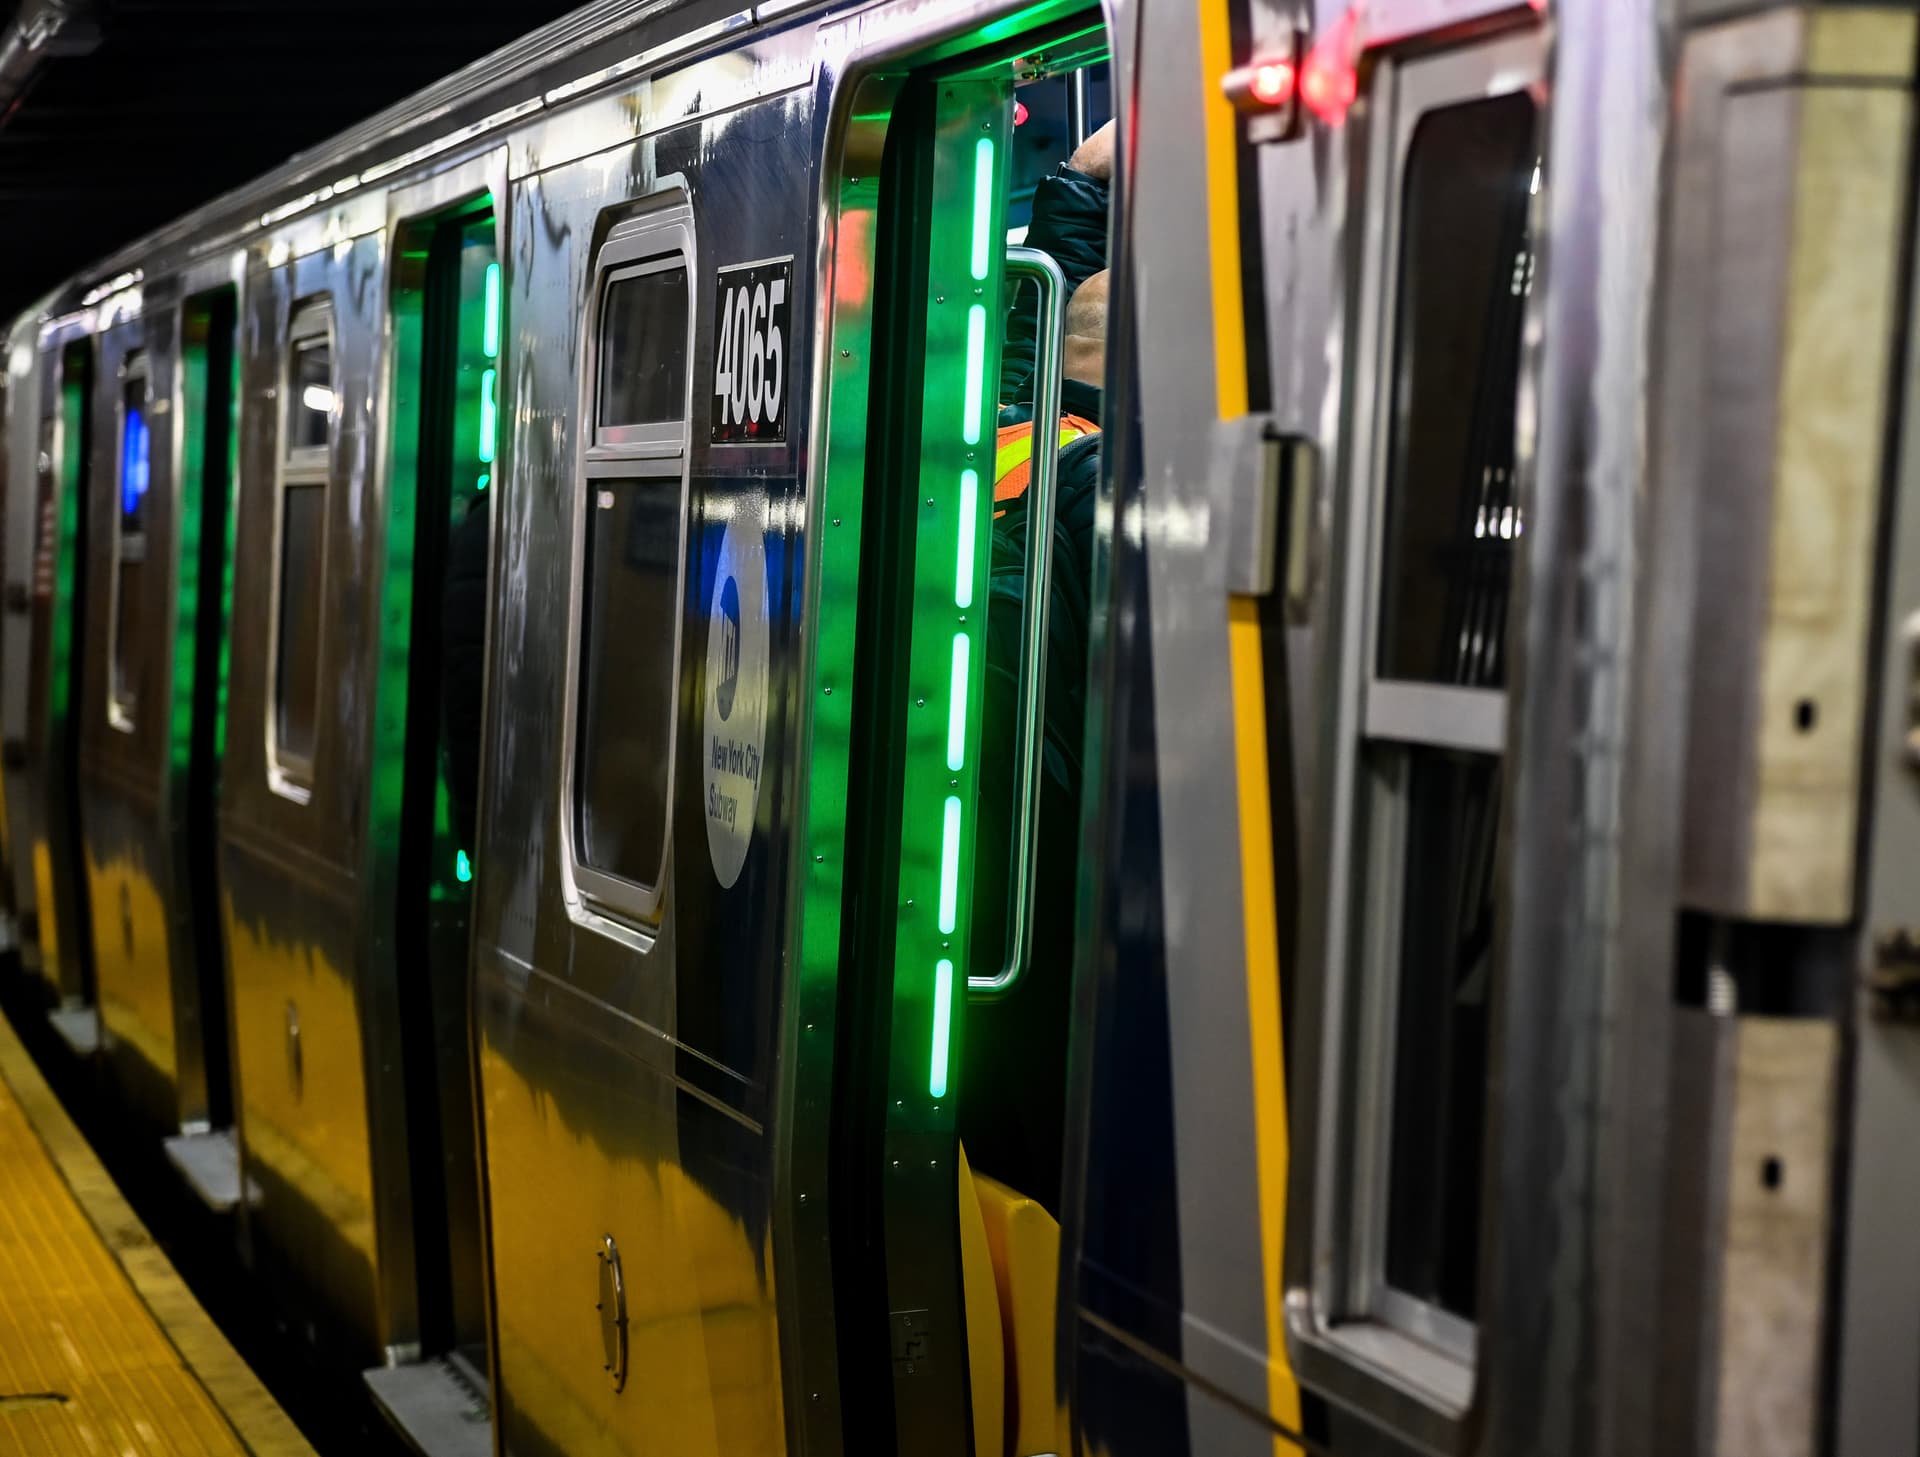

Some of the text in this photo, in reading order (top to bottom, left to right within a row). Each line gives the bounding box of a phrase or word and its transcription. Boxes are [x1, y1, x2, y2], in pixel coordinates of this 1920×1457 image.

[715, 278, 785, 425] 4065
[711, 735, 761, 791] New York City
[708, 782, 738, 833] Subway
